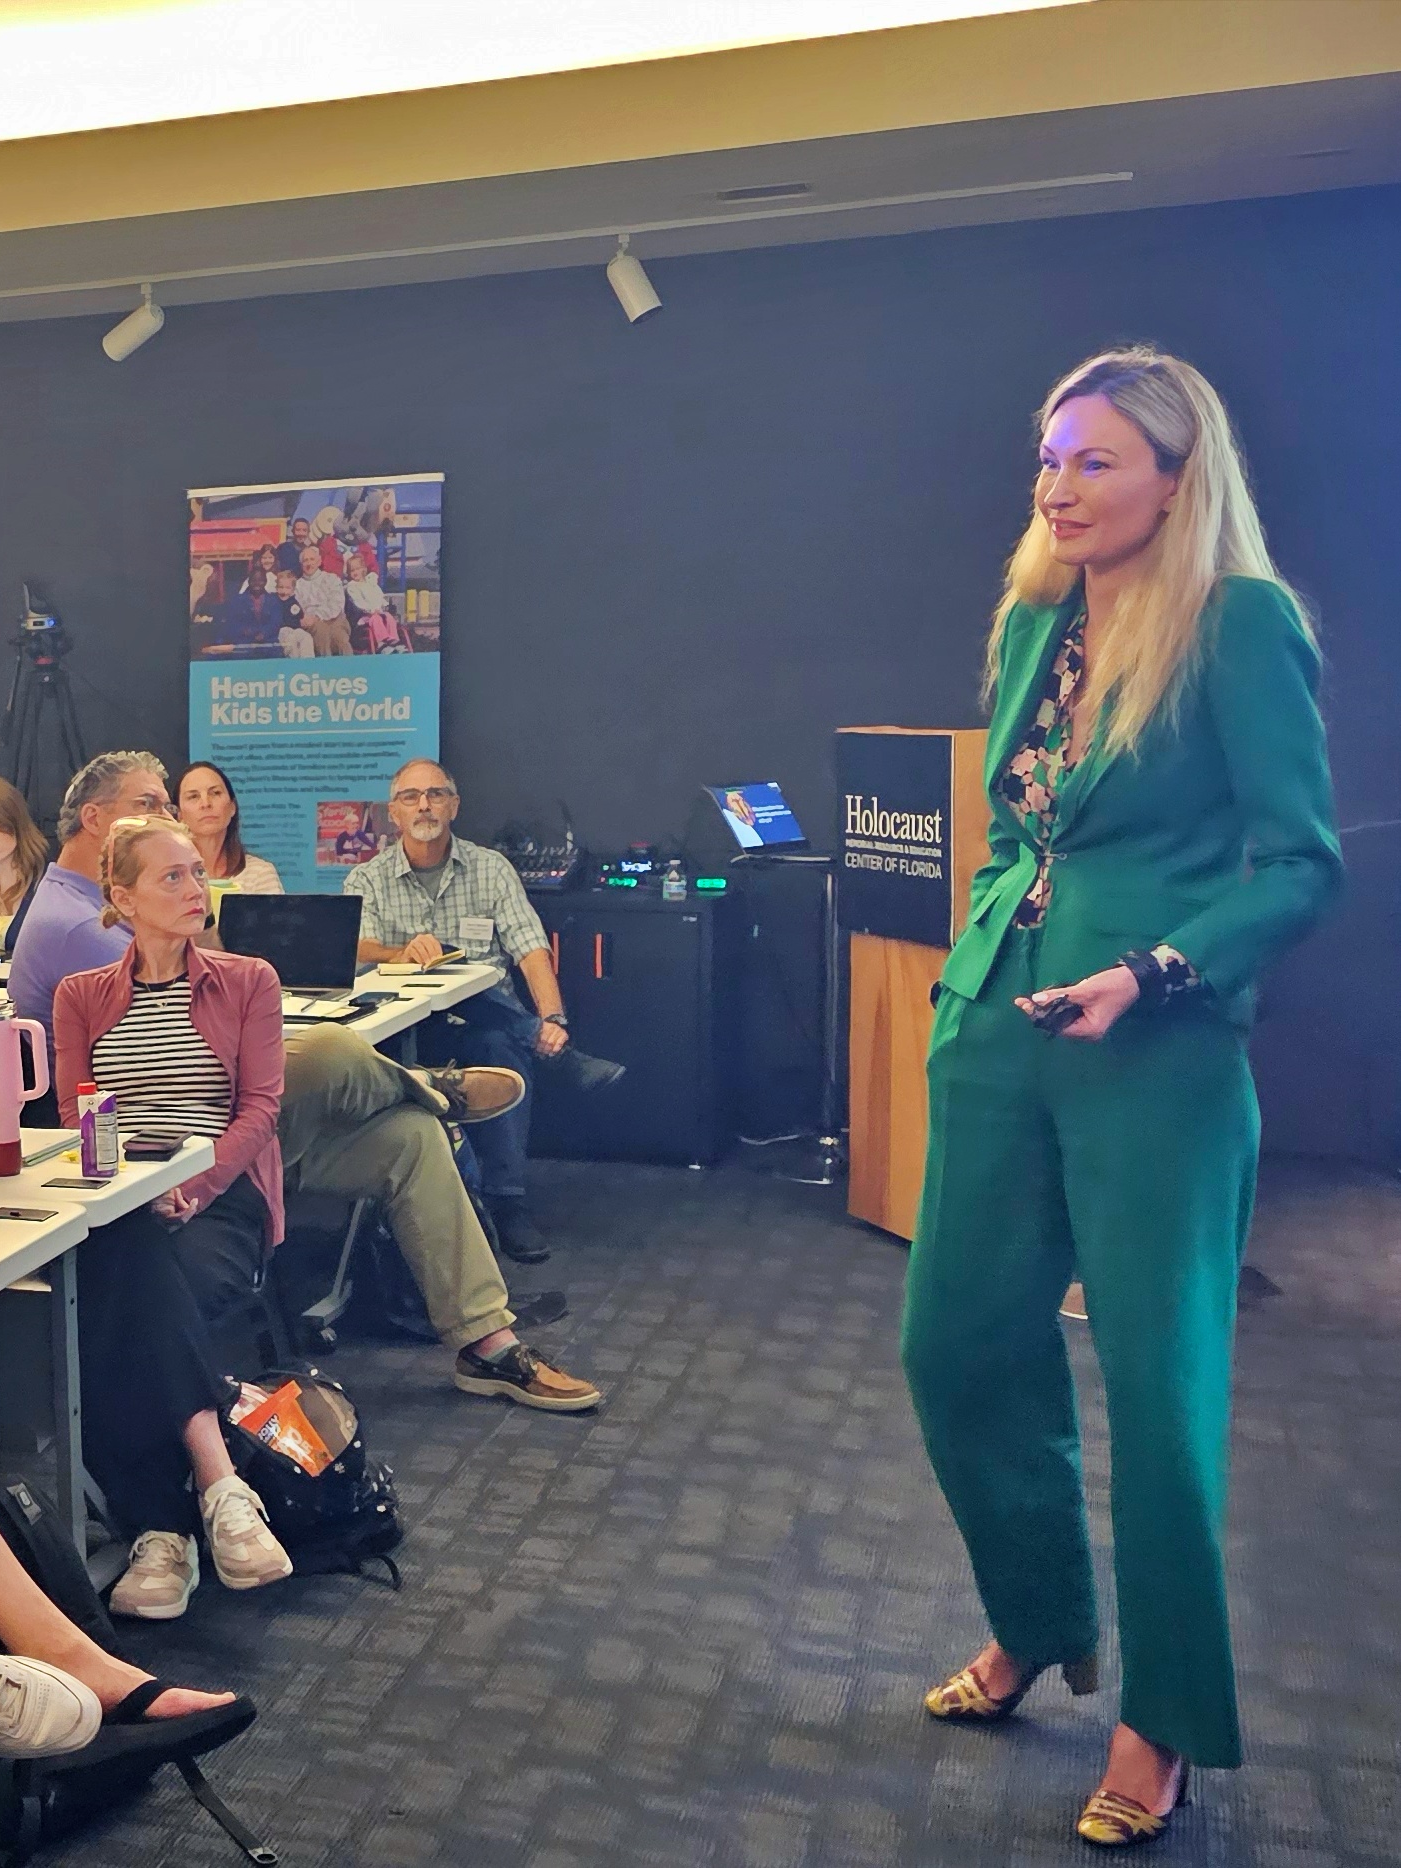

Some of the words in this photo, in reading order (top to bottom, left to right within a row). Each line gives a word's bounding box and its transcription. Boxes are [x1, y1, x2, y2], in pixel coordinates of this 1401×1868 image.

[211, 673, 285, 699] Henri
[289, 673, 369, 698] Gives
[211, 701, 272, 726] Kids
[277, 700, 323, 723] the
[327, 696, 411, 722] World
[845, 794, 943, 843] Holocaust
[845, 851, 883, 871] CENTER
[884, 856, 897, 873] OF
[899, 858, 943, 879] FLORIDA
